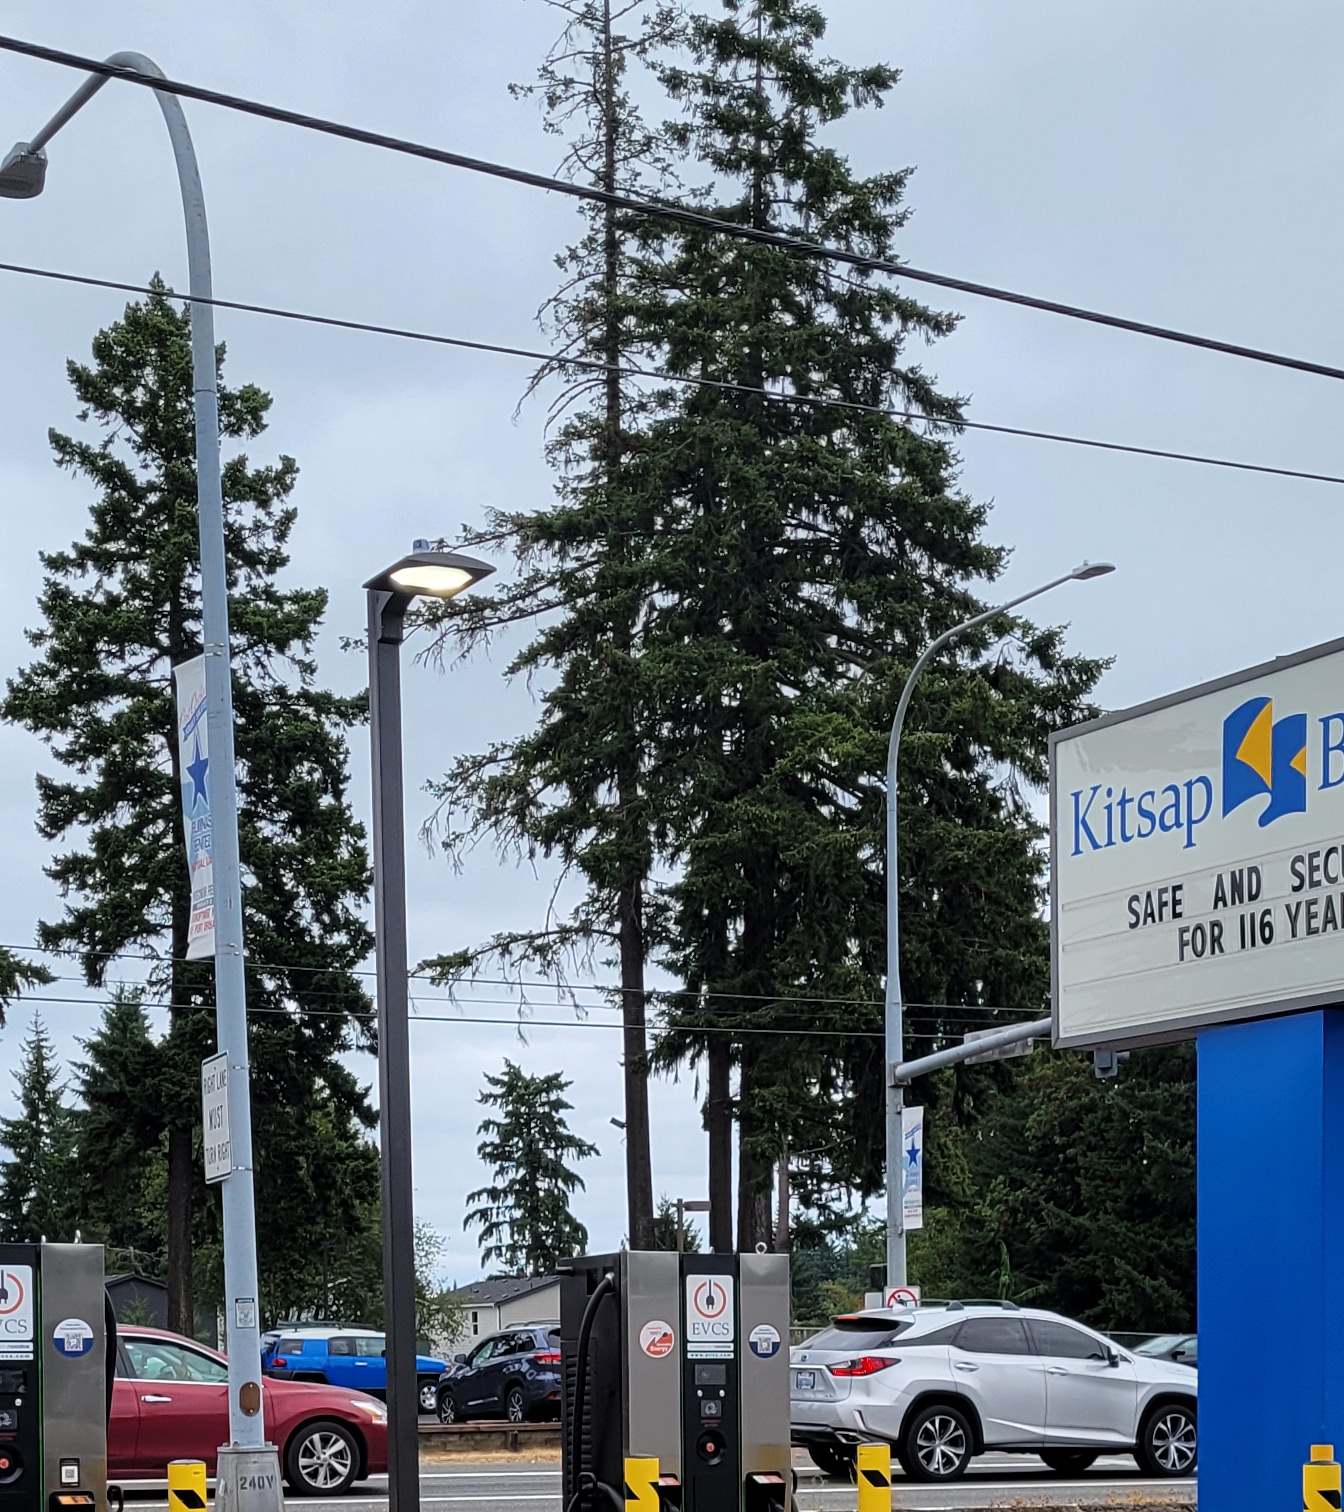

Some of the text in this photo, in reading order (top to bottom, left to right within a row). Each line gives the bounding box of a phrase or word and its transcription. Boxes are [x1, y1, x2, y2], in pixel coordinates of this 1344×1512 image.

[1069, 774, 1213, 856] Kitsap
[1127, 883, 1185, 930] SAFE
[1212, 864, 1262, 911] AND
[1178, 918, 1225, 963] FOR
[1239, 907, 1275, 949] 116
[204, 1069, 227, 1095] RIGHT LANE
[208, 1105, 224, 1131] MUST
[206, 1142, 230, 1166] TURN RIGHT
[692, 1322, 730, 1336] EVCS
[239, 1474, 274, 1490] 240V
